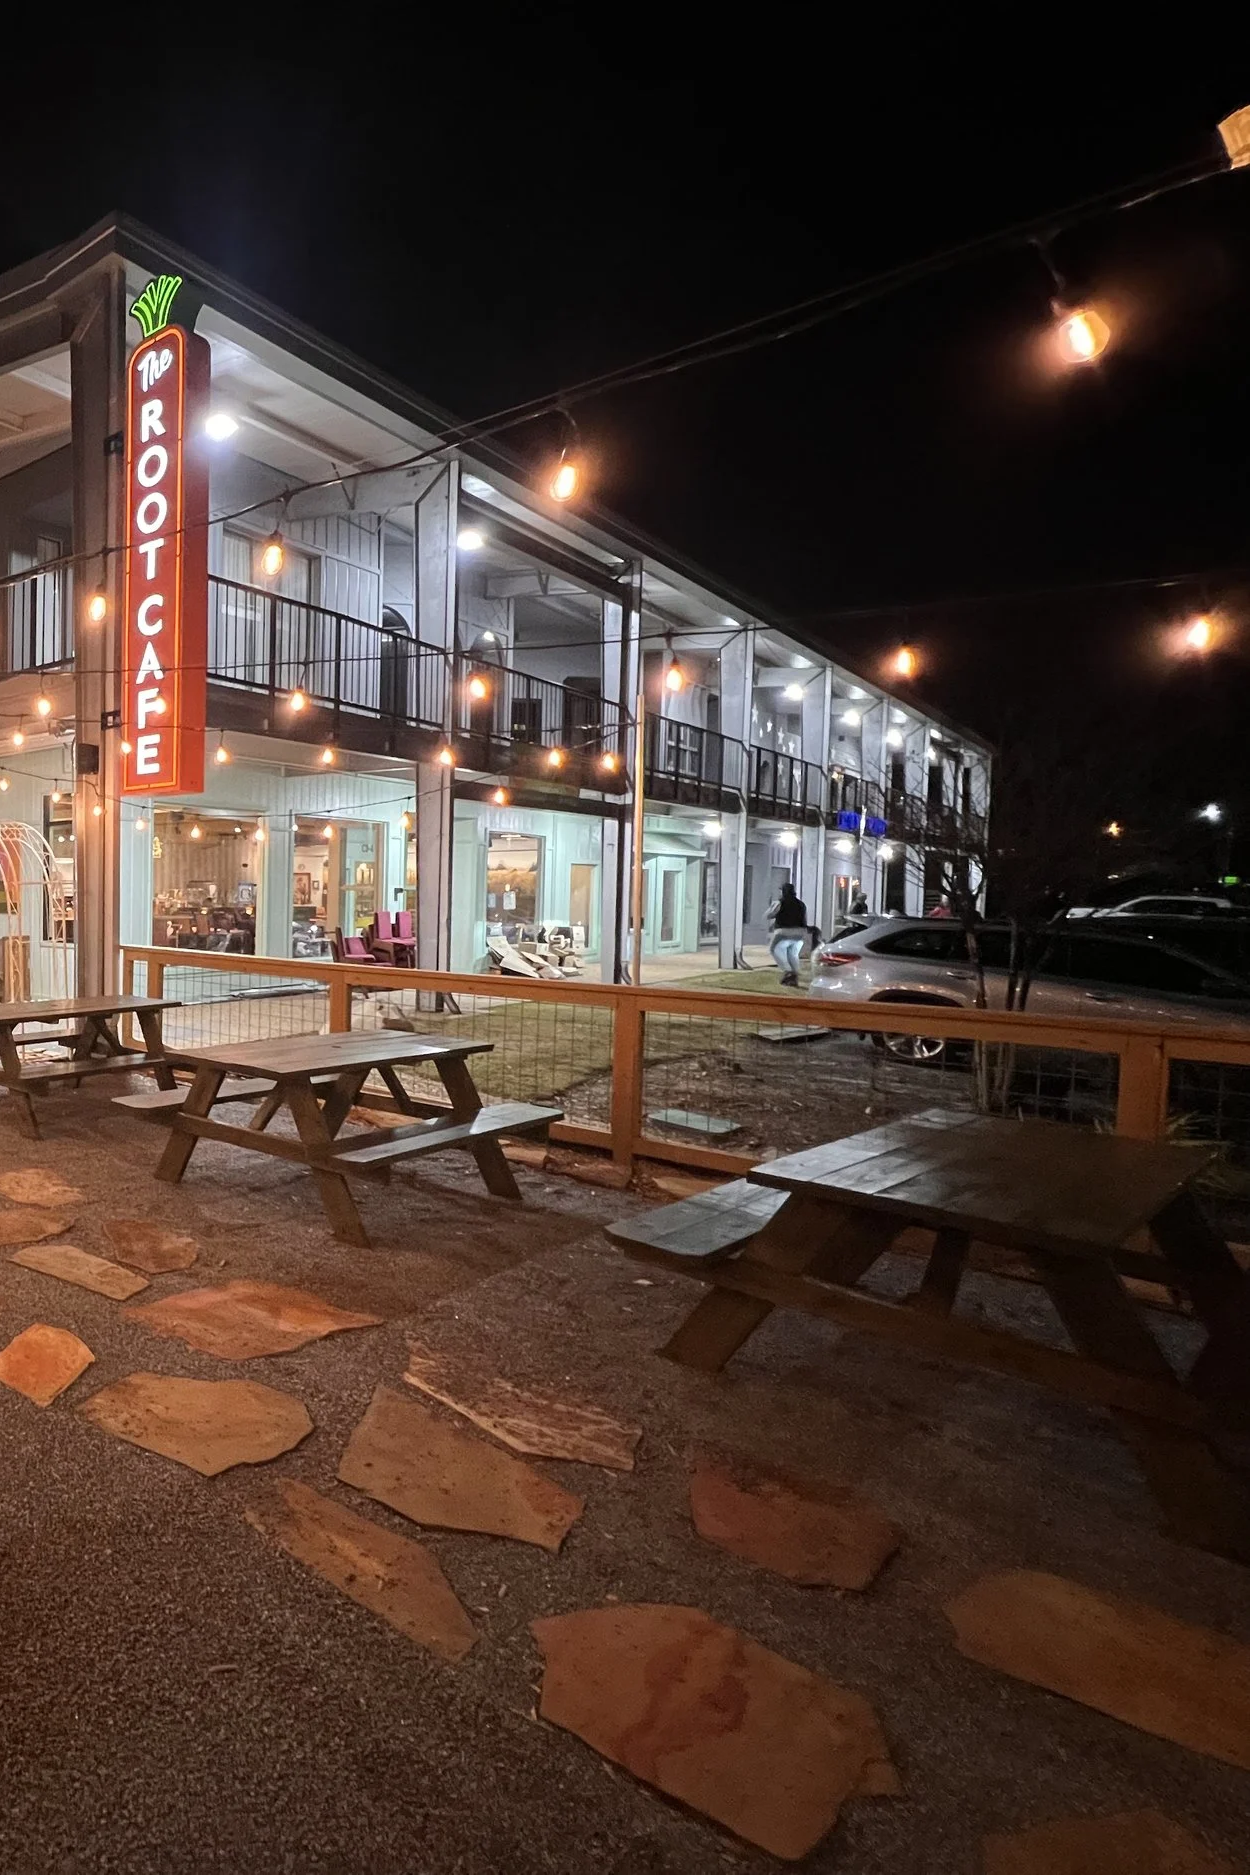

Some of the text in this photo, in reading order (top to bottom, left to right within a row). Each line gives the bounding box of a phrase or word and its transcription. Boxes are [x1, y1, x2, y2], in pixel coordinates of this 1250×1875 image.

[137, 348, 173, 393] The
[135, 398, 168, 776] ROOT CAFE
